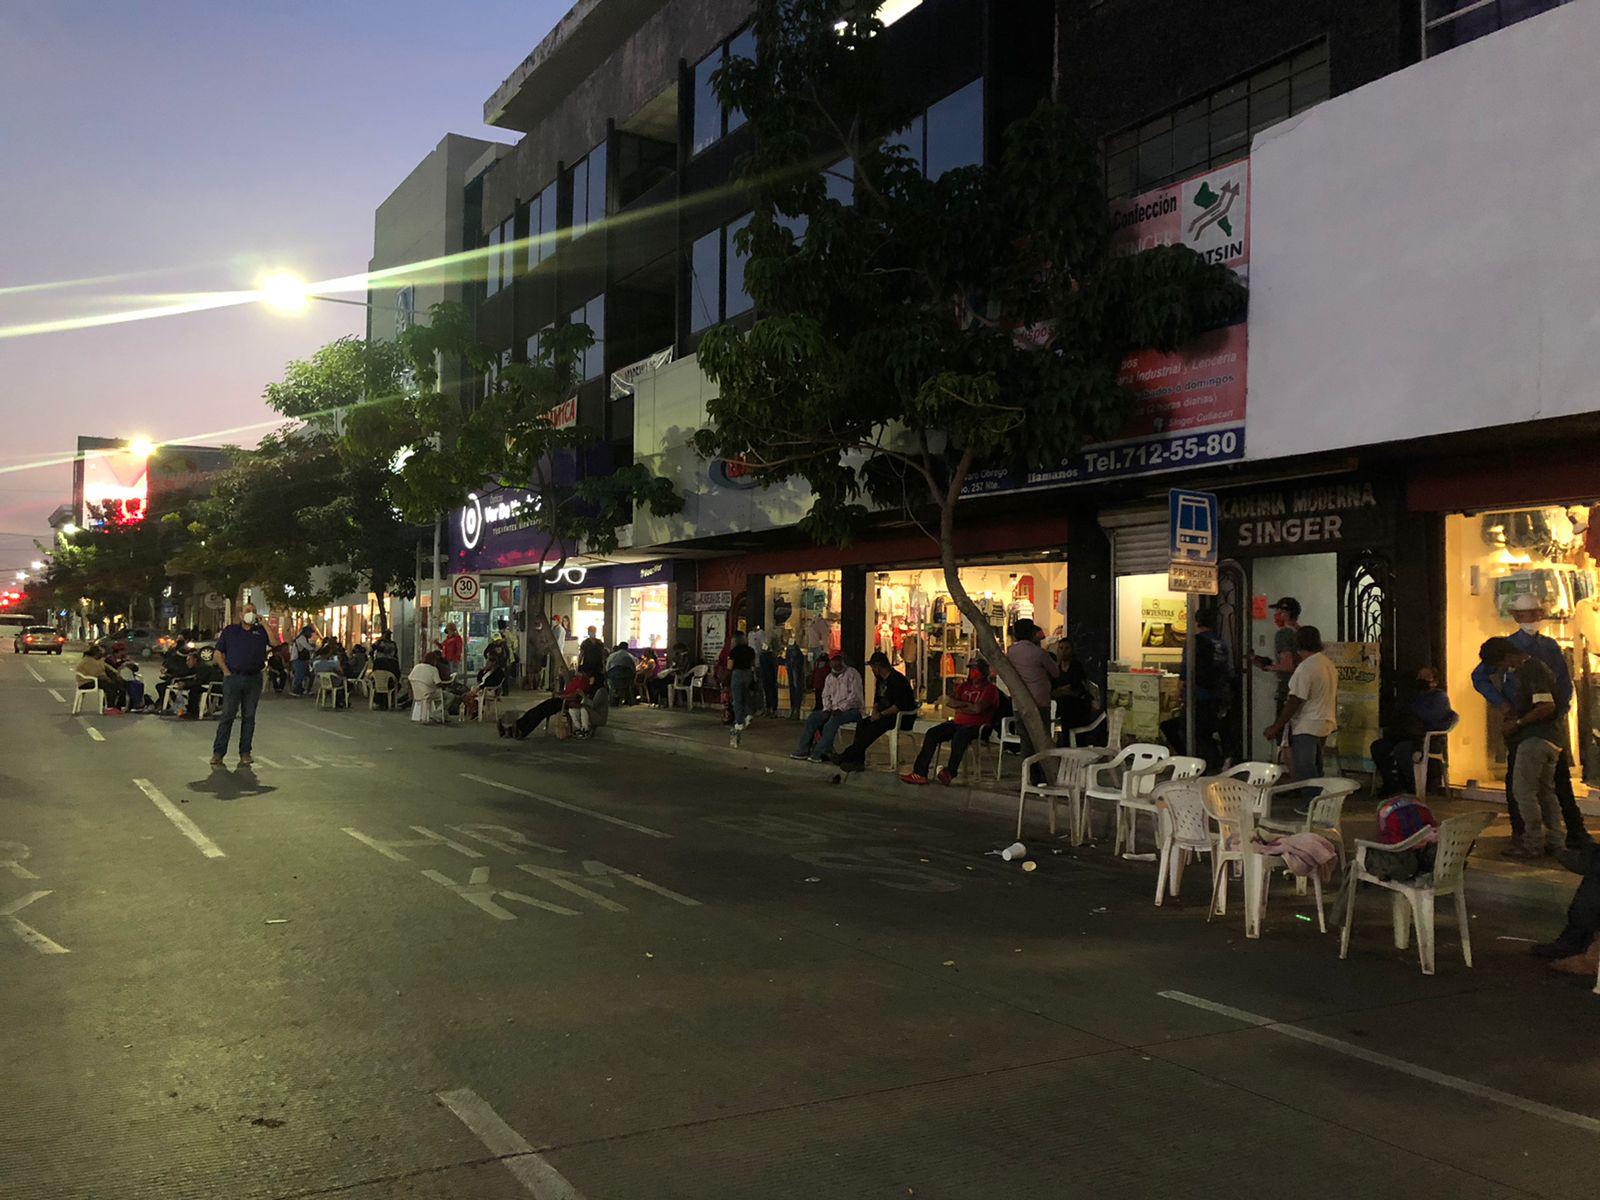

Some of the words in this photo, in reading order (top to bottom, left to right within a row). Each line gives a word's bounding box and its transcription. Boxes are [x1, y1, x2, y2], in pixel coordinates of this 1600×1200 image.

[1199, 241, 1242, 265] ATSIN
[1184, 376, 1234, 393] domingos
[1218, 490, 1286, 518] CADEMIA
[1238, 514, 1343, 547] SINGER
[459, 580, 472, 591] 30
